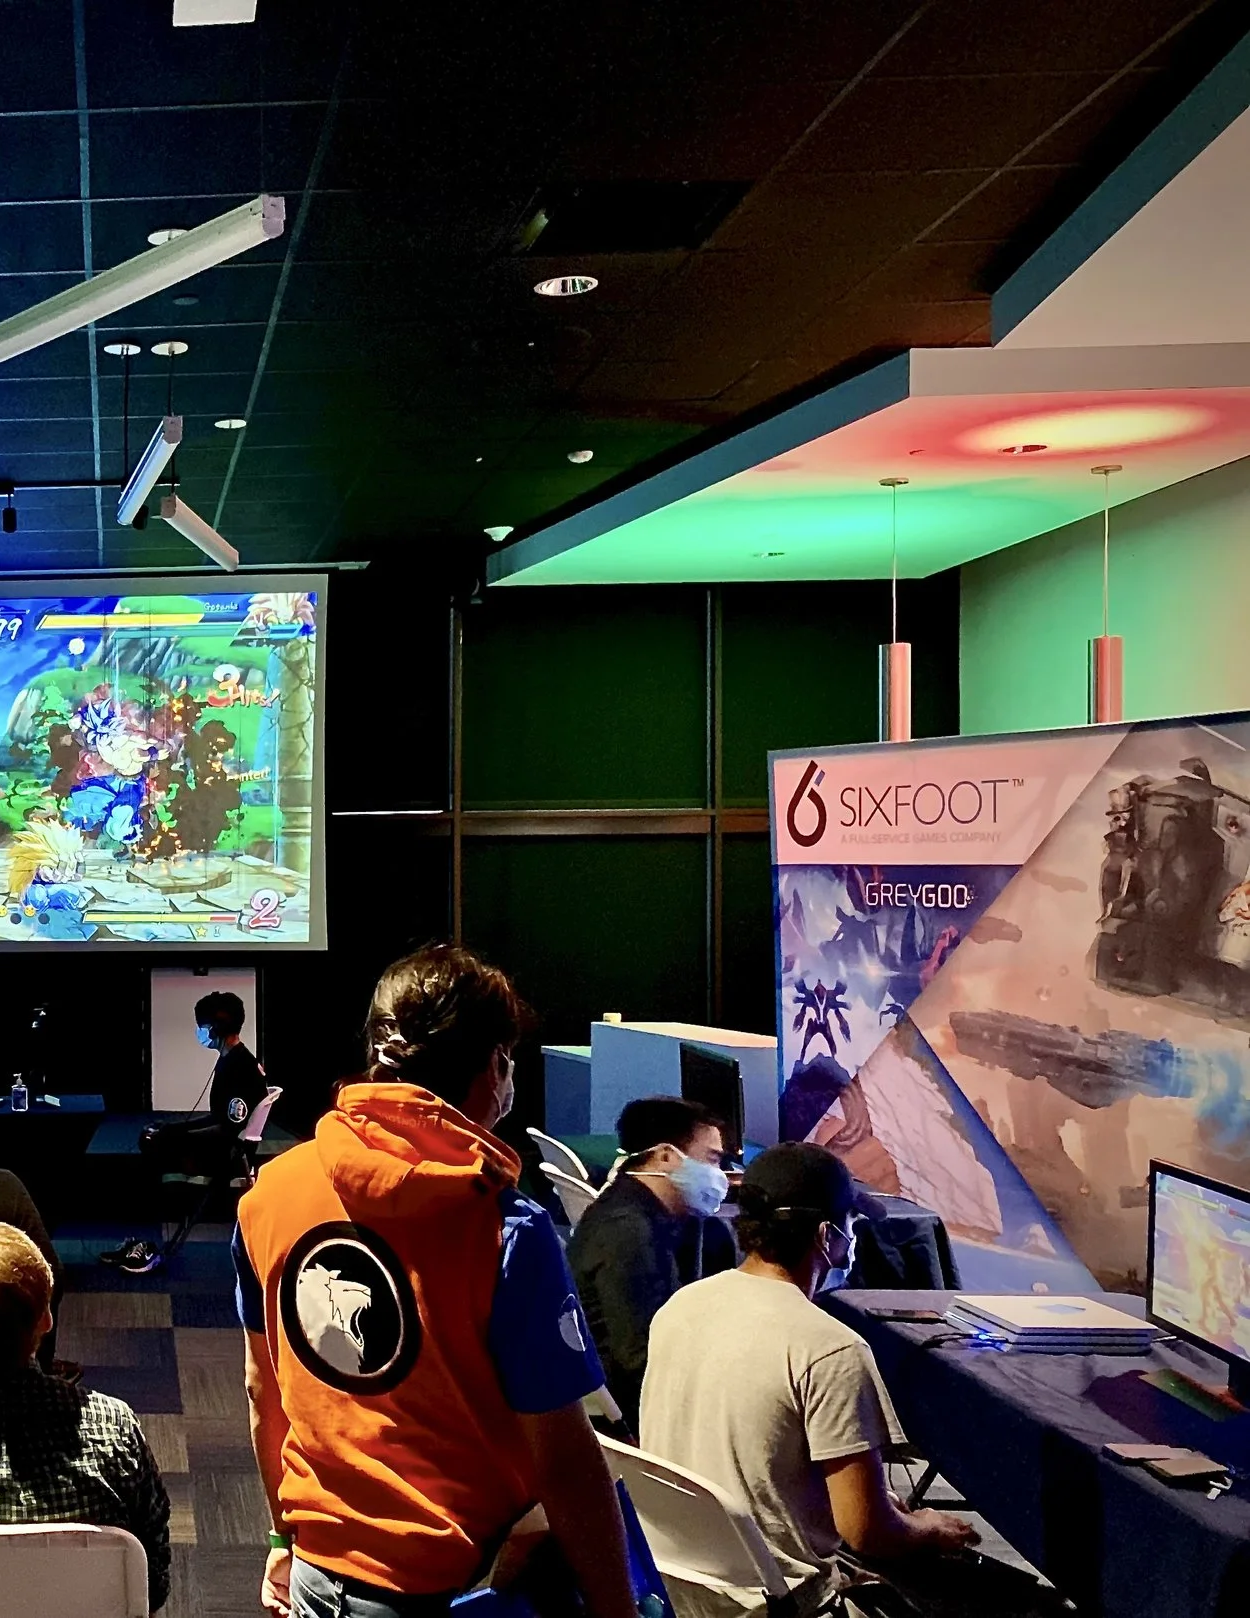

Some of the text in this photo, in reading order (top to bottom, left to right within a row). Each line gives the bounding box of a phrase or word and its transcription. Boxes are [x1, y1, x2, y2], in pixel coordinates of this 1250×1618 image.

[840, 779, 1009, 828] SIXFOOT
[913, 832, 948, 843] GAMES
[949, 831, 1001, 842] COMPANY
[249, 888, 282, 928] 2
